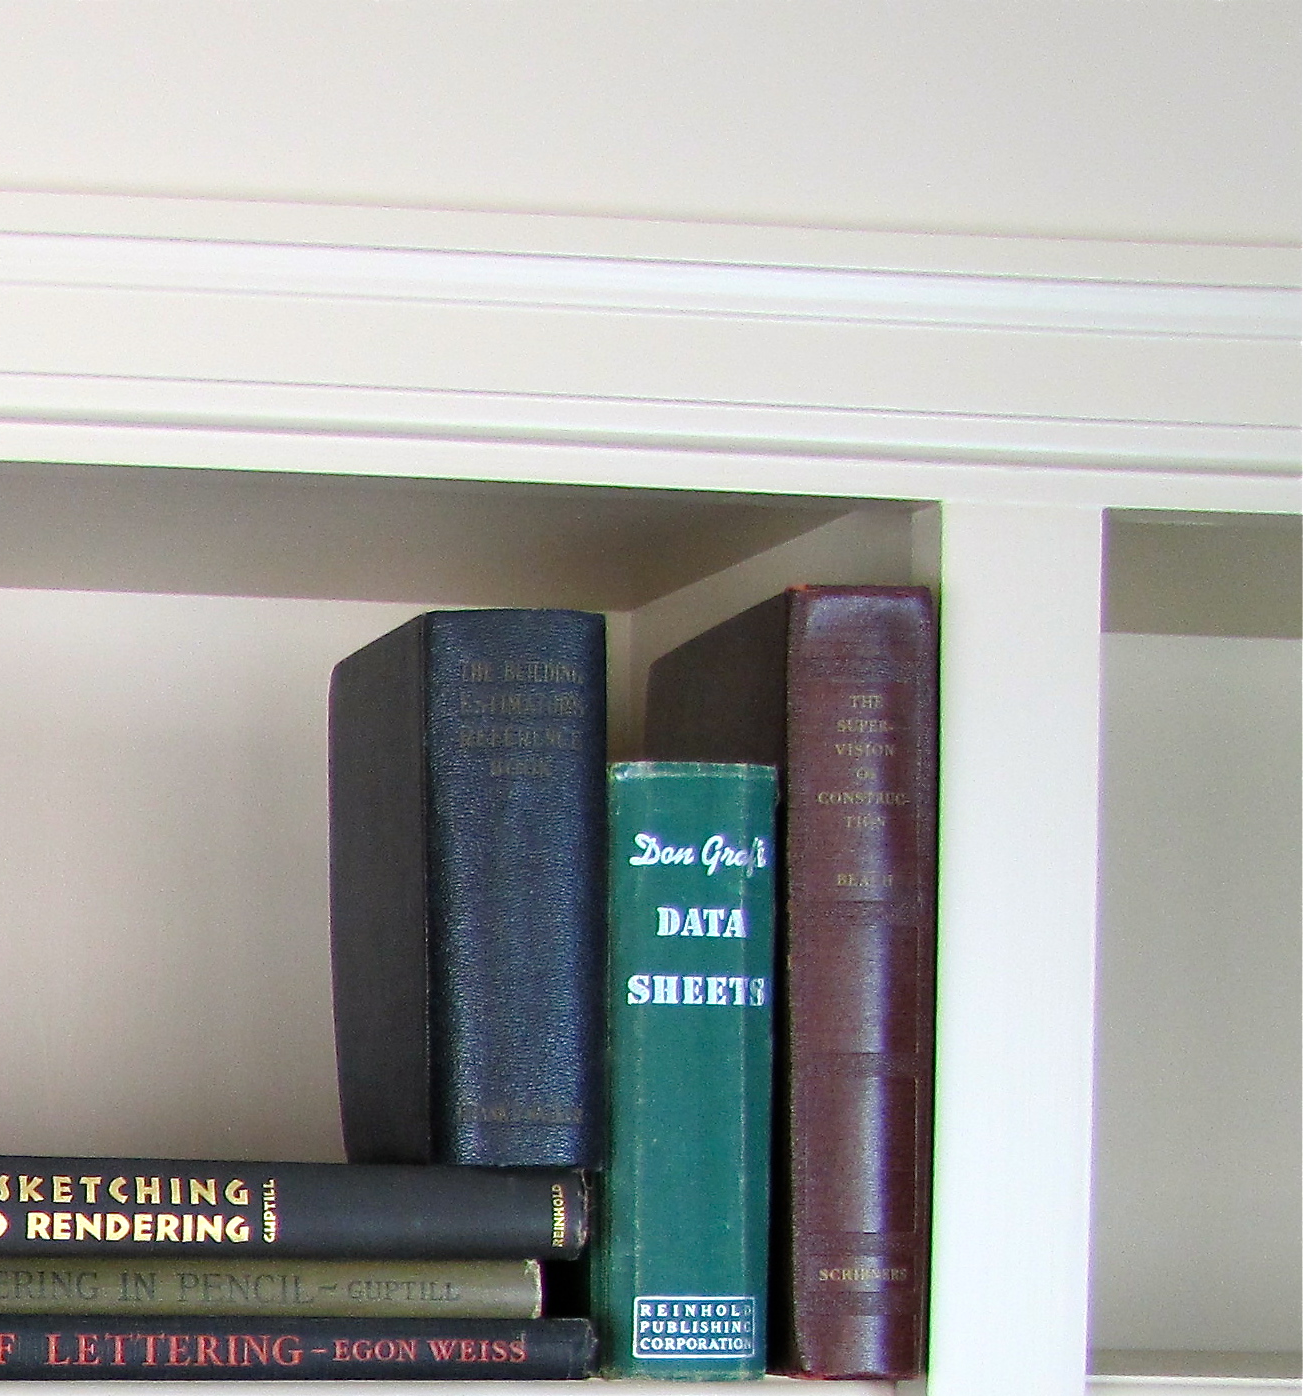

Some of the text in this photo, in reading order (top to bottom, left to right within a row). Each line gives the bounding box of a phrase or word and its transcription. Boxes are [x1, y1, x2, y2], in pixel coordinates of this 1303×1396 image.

[849, 695, 883, 709] THE
[834, 743, 895, 757] VISION
[628, 833, 696, 868] Don
[655, 906, 748, 939] DATA
[626, 974, 765, 1007] SHEETS
[25, 1209, 251, 1243] RENDERING
[262, 1178, 278, 1243] GUPTILL
[550, 1183, 565, 1249] REINHOLD
[117, 1270, 156, 1302] IN
[178, 1271, 313, 1305] PENCIL
[44, 1332, 304, 1367] LETTERING
[332, 1338, 419, 1363] EGON
[425, 1339, 528, 1364] WEISS
